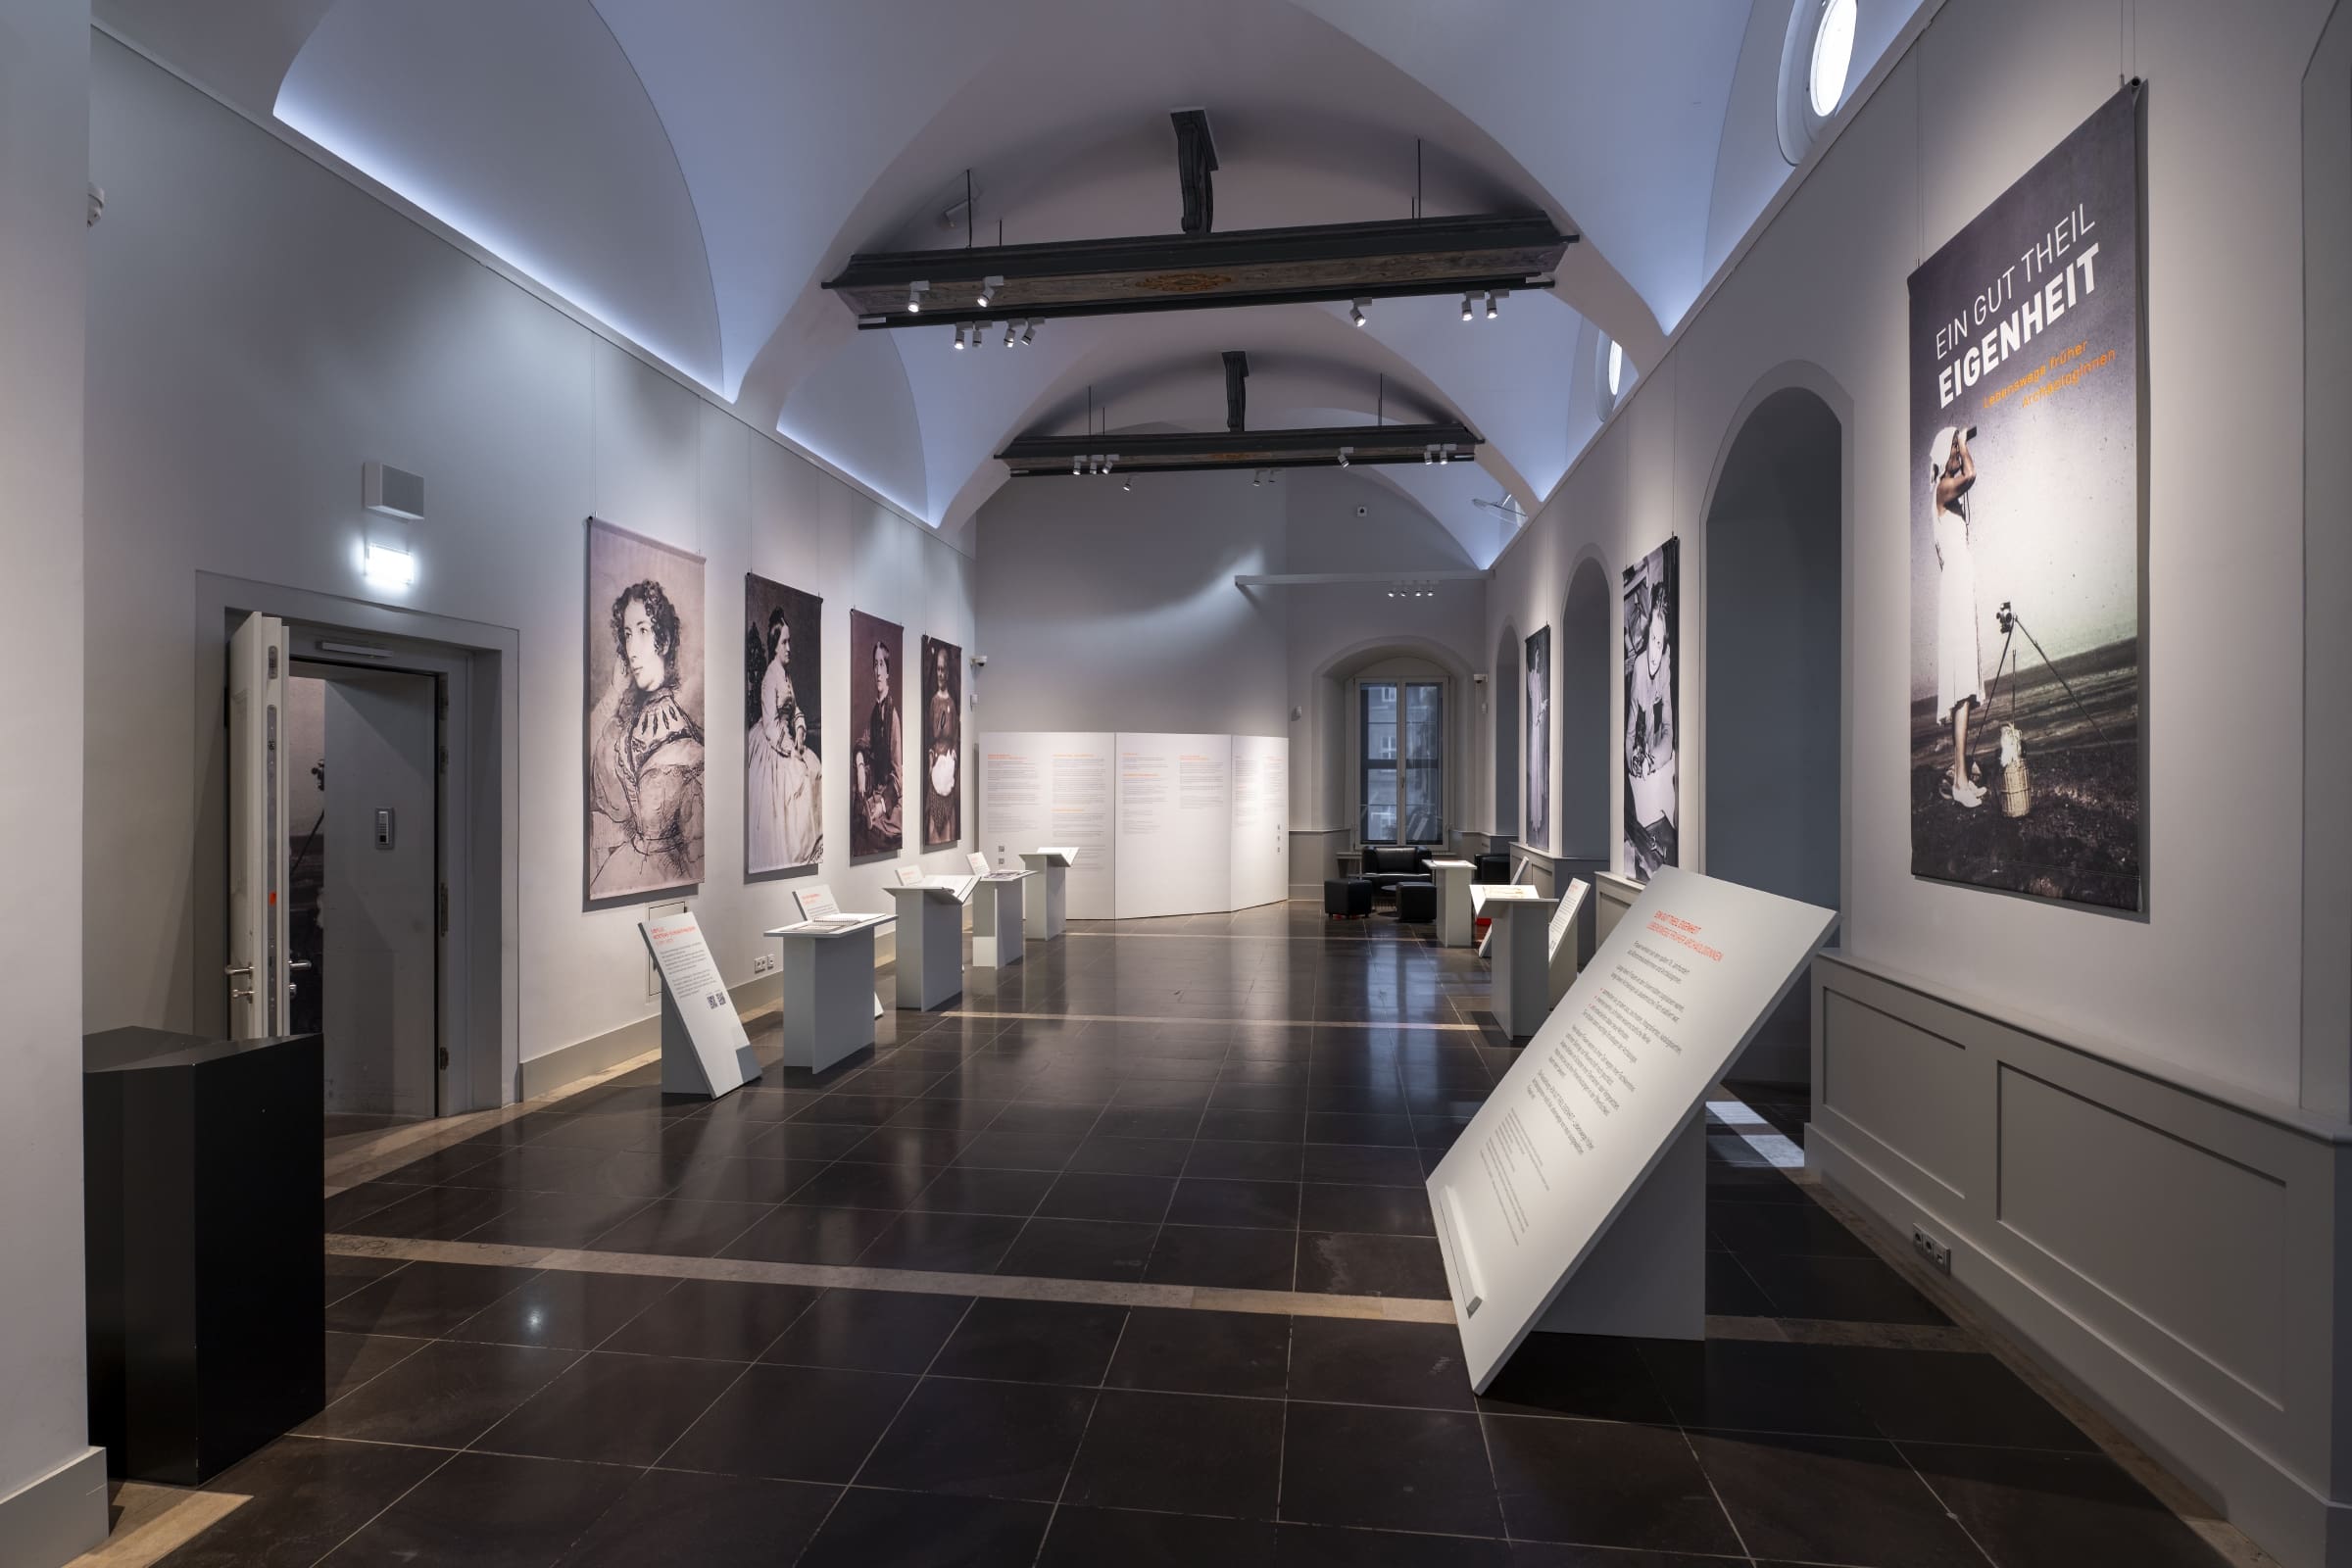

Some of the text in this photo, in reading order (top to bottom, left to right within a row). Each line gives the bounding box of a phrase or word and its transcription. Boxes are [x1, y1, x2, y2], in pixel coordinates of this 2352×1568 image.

[1936, 203, 2095, 361] EIN GUT THEIL
[1938, 242, 2099, 410] EIGENHEIT
